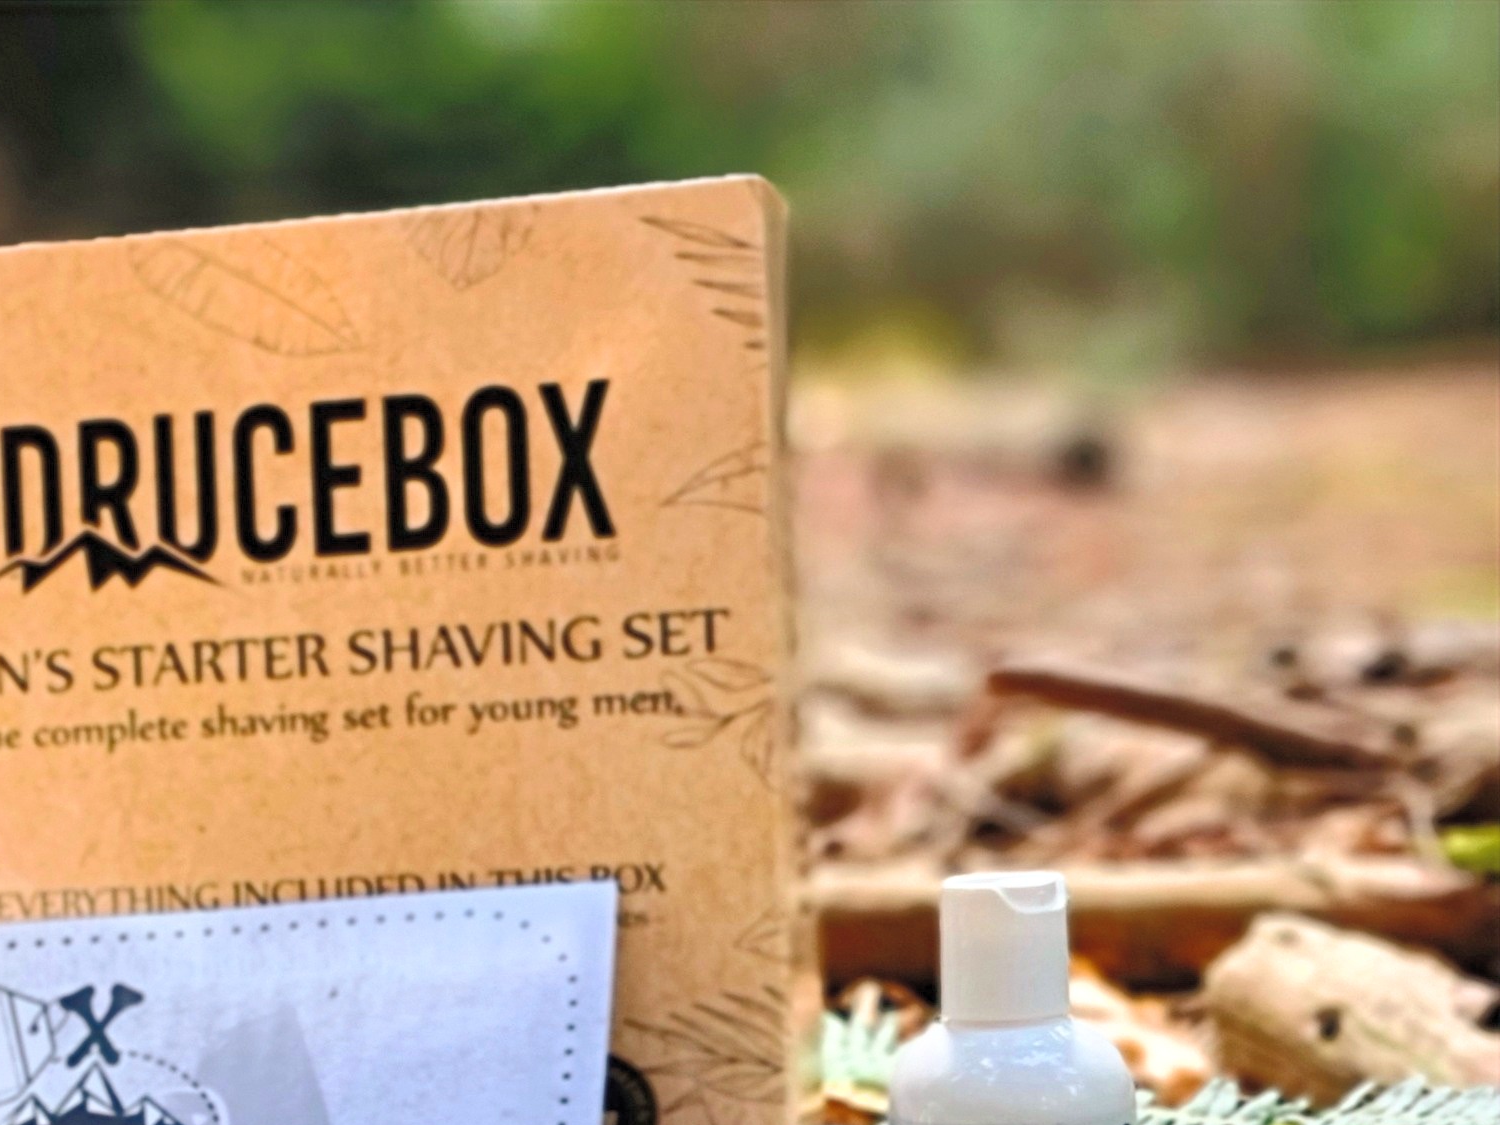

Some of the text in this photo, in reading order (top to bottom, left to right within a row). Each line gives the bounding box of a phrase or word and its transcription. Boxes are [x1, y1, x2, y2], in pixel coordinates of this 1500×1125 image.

[0, 378, 617, 566] DRUCEBOX
[91, 632, 331, 692] STARTER
[347, 614, 603, 677] SHAVING
[621, 607, 731, 661] SET
[32, 708, 189, 755] complete
[200, 702, 330, 745] shaving
[342, 702, 392, 730] set
[404, 690, 456, 727] for
[467, 694, 578, 736] young
